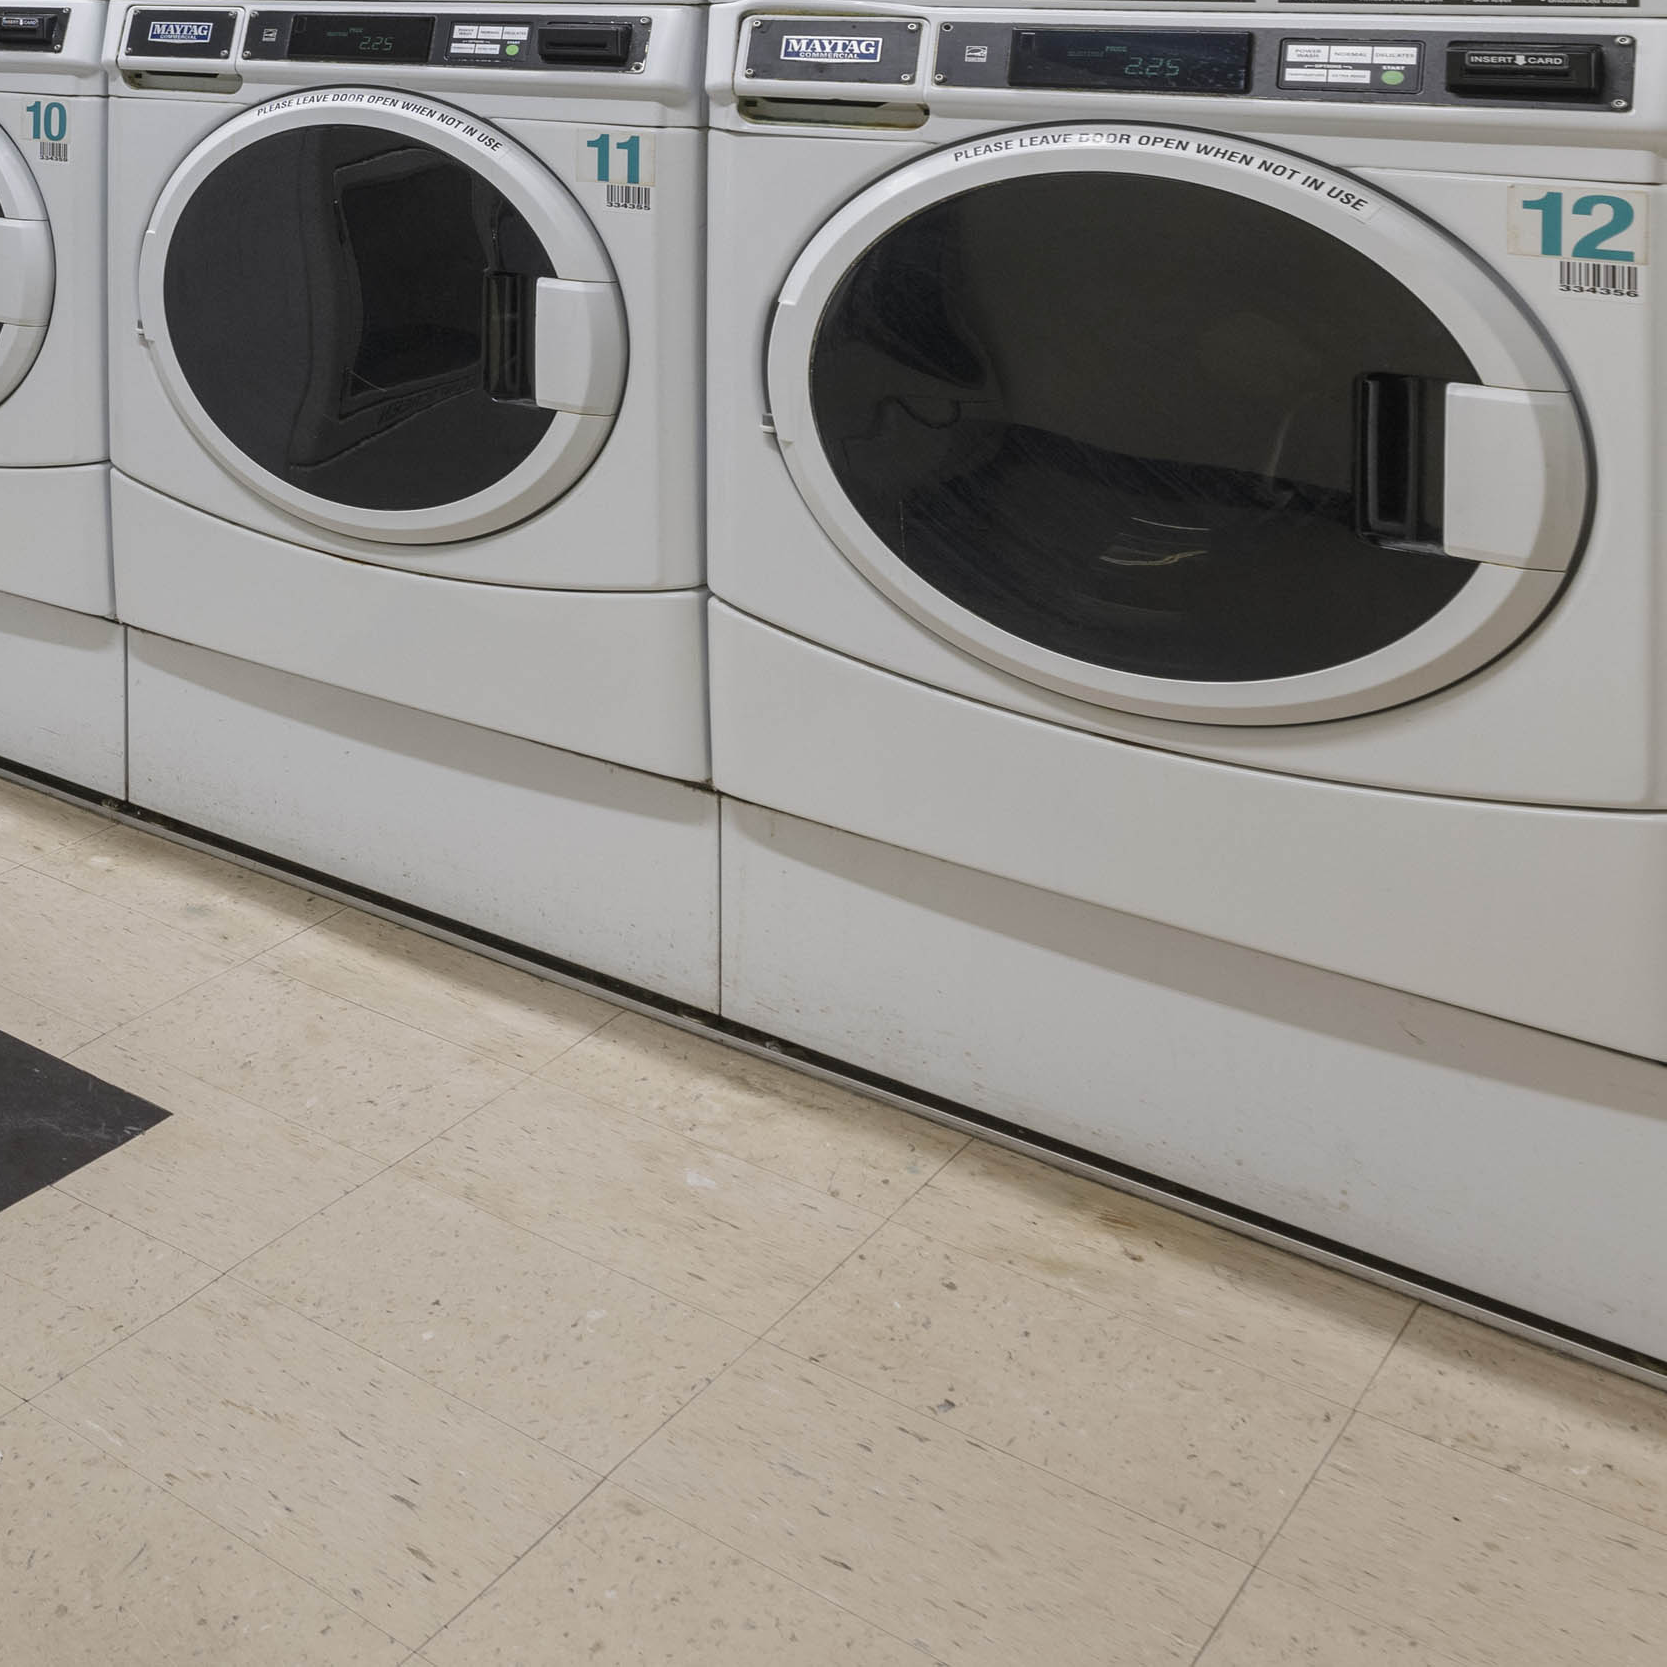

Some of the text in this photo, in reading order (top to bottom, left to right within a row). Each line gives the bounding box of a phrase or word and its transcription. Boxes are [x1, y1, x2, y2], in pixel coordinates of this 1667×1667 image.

[153, 24, 209, 35] MAYTAG
[359, 37, 394, 51] 2.25
[787, 40, 876, 53] MAYTAG
[1125, 57, 1180, 76] 2.25
[1471, 55, 1562, 65] INSERT CARD
[27, 101, 66, 141] 10
[257, 94, 503, 152] PLEASE LEAVE DOOR OPEN WHEN NOT IN USE
[587, 134, 639, 184] 11
[954, 133, 1368, 212] PLEASE LEAVE DOOR OPEN WHEN NOT IN USE
[1523, 192, 1635, 262] 12
[1559, 285, 1639, 297] 334356
